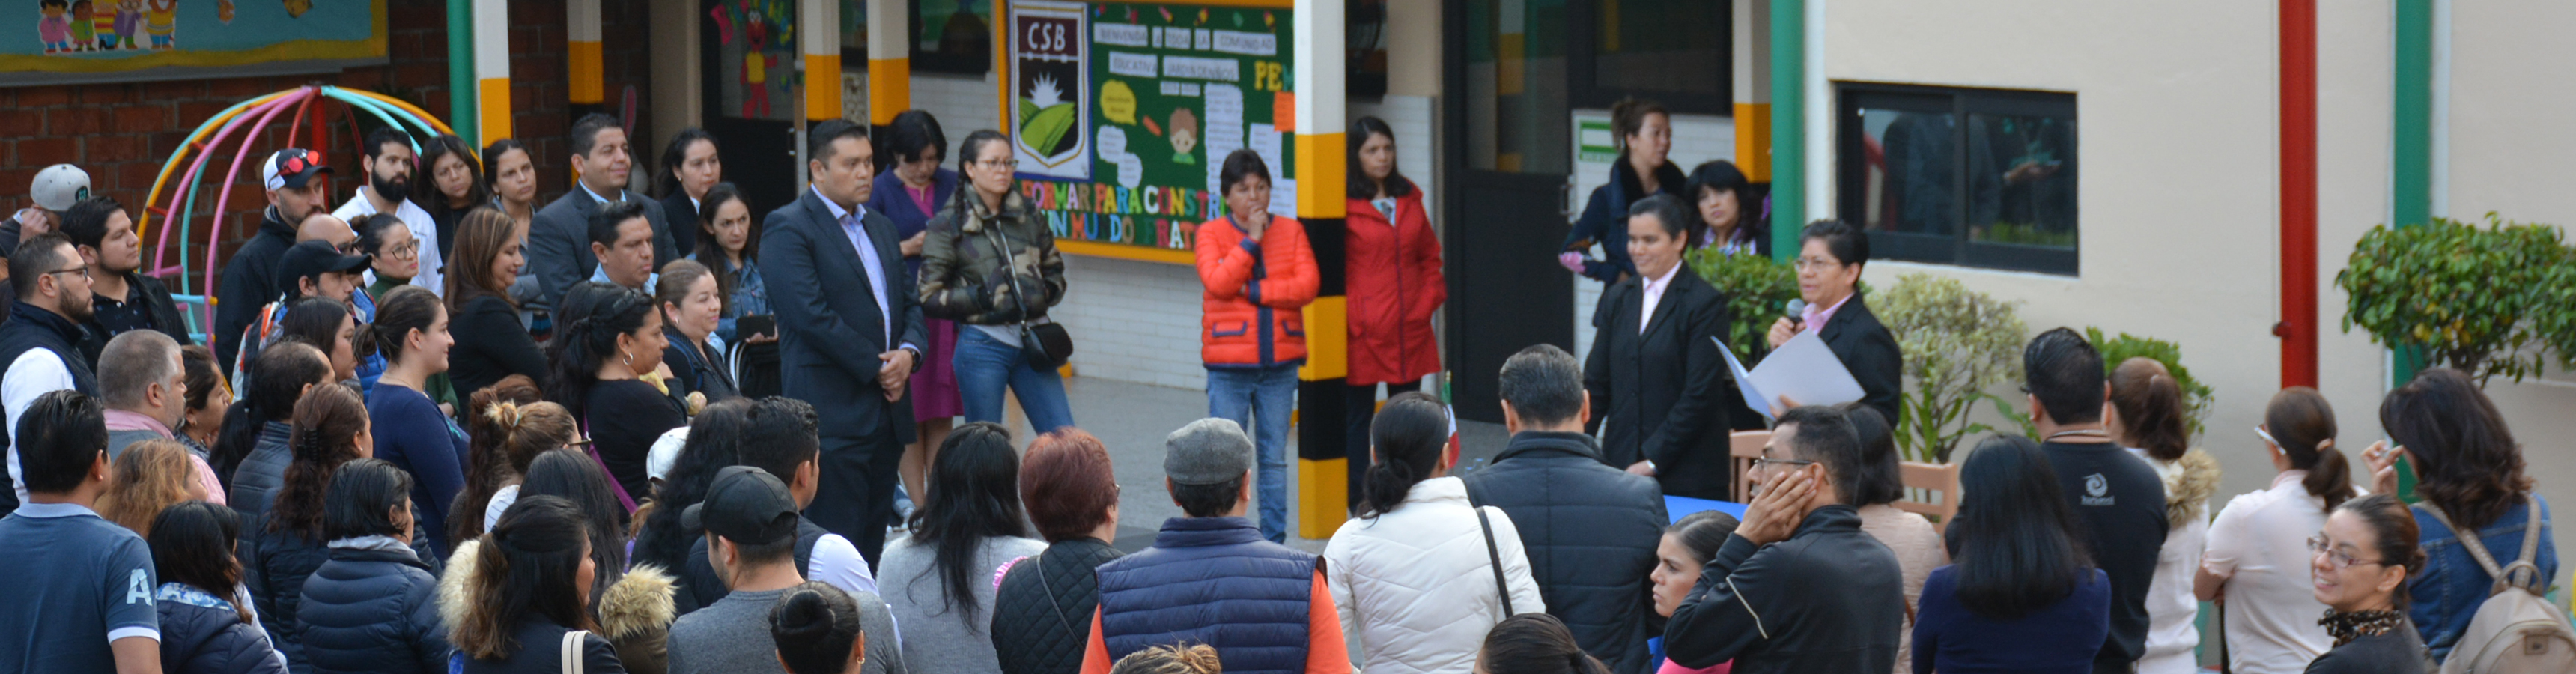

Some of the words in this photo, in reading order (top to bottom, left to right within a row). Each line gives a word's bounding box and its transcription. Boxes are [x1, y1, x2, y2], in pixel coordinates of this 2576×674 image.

[1028, 22, 1066, 52] CSB
[1094, 182, 1143, 215] PARA
[1071, 211, 1134, 245] MUNDO
[1145, 216, 1200, 250] FRAT
[126, 568, 153, 607] A
